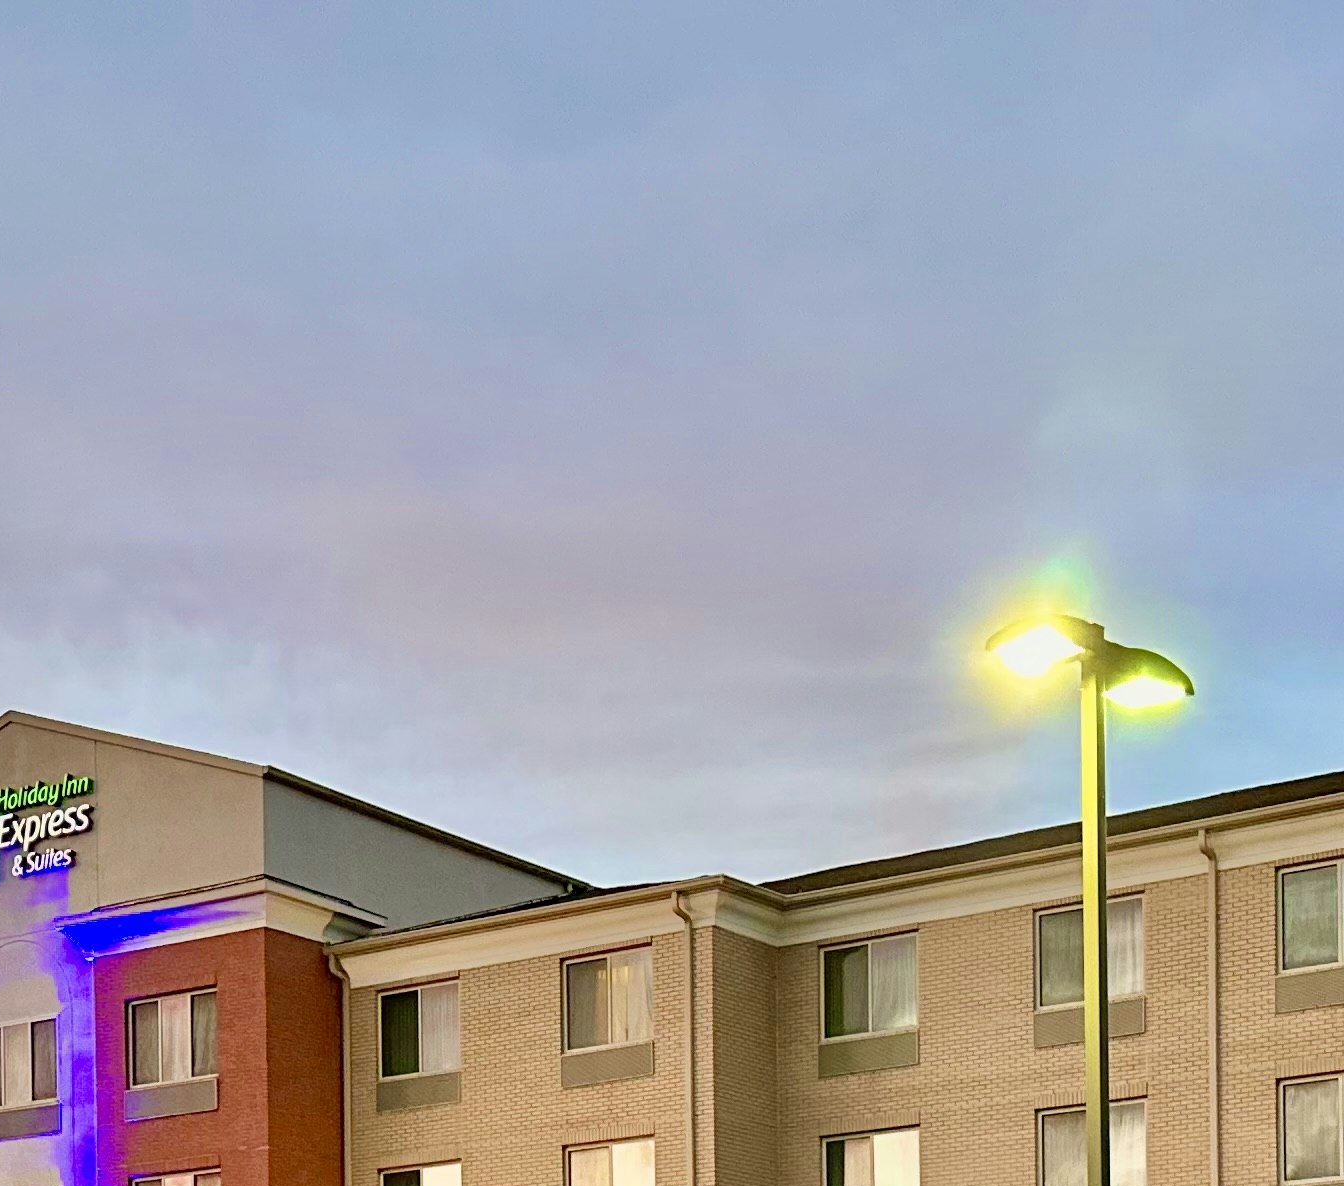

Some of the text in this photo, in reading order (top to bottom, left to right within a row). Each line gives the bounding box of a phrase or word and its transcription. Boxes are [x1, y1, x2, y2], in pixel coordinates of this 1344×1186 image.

[62, 773, 89, 797] Inn
[12, 849, 72, 877] & Suites
